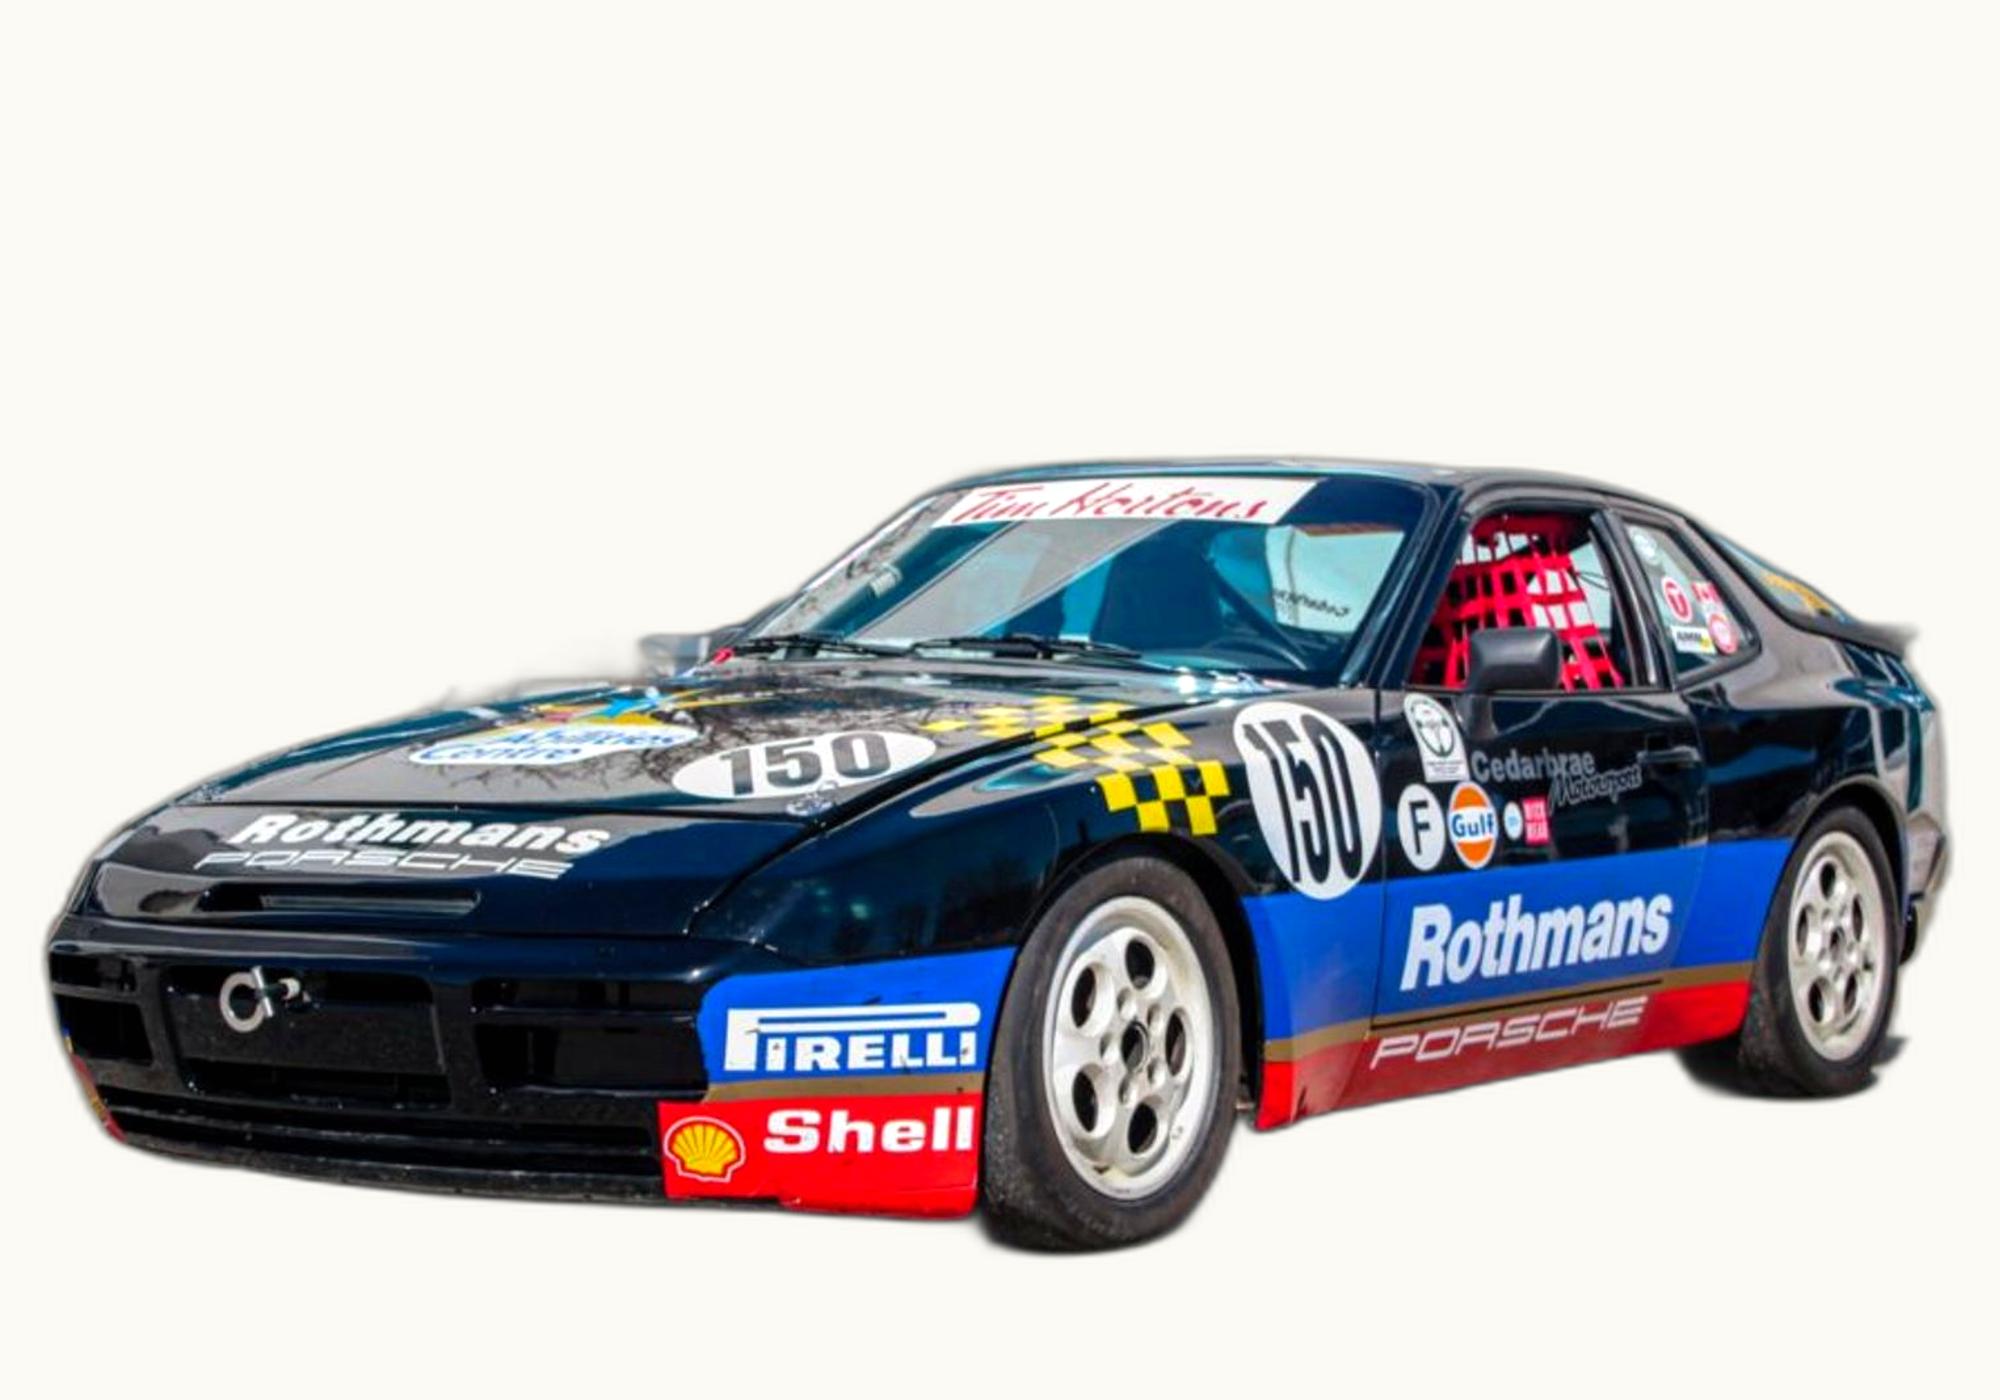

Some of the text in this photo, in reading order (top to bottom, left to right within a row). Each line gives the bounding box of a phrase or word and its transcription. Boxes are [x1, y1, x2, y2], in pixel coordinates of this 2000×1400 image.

[951, 482, 1268, 523] Tim Hortons
[719, 732, 891, 796] 150
[1471, 747, 1596, 783] Cedarbrae
[1241, 713, 1364, 884] 150
[1451, 812, 1494, 838] Gulf
[227, 812, 611, 855] Rothmans
[1408, 799, 1431, 857] F
[193, 848, 575, 879] PORSCHE
[1399, 893, 1674, 992] Rothmans
[723, 1001, 982, 1072] PIRELLI
[1369, 995, 1649, 1071] PORSCHE
[762, 1105, 976, 1154] Shell
